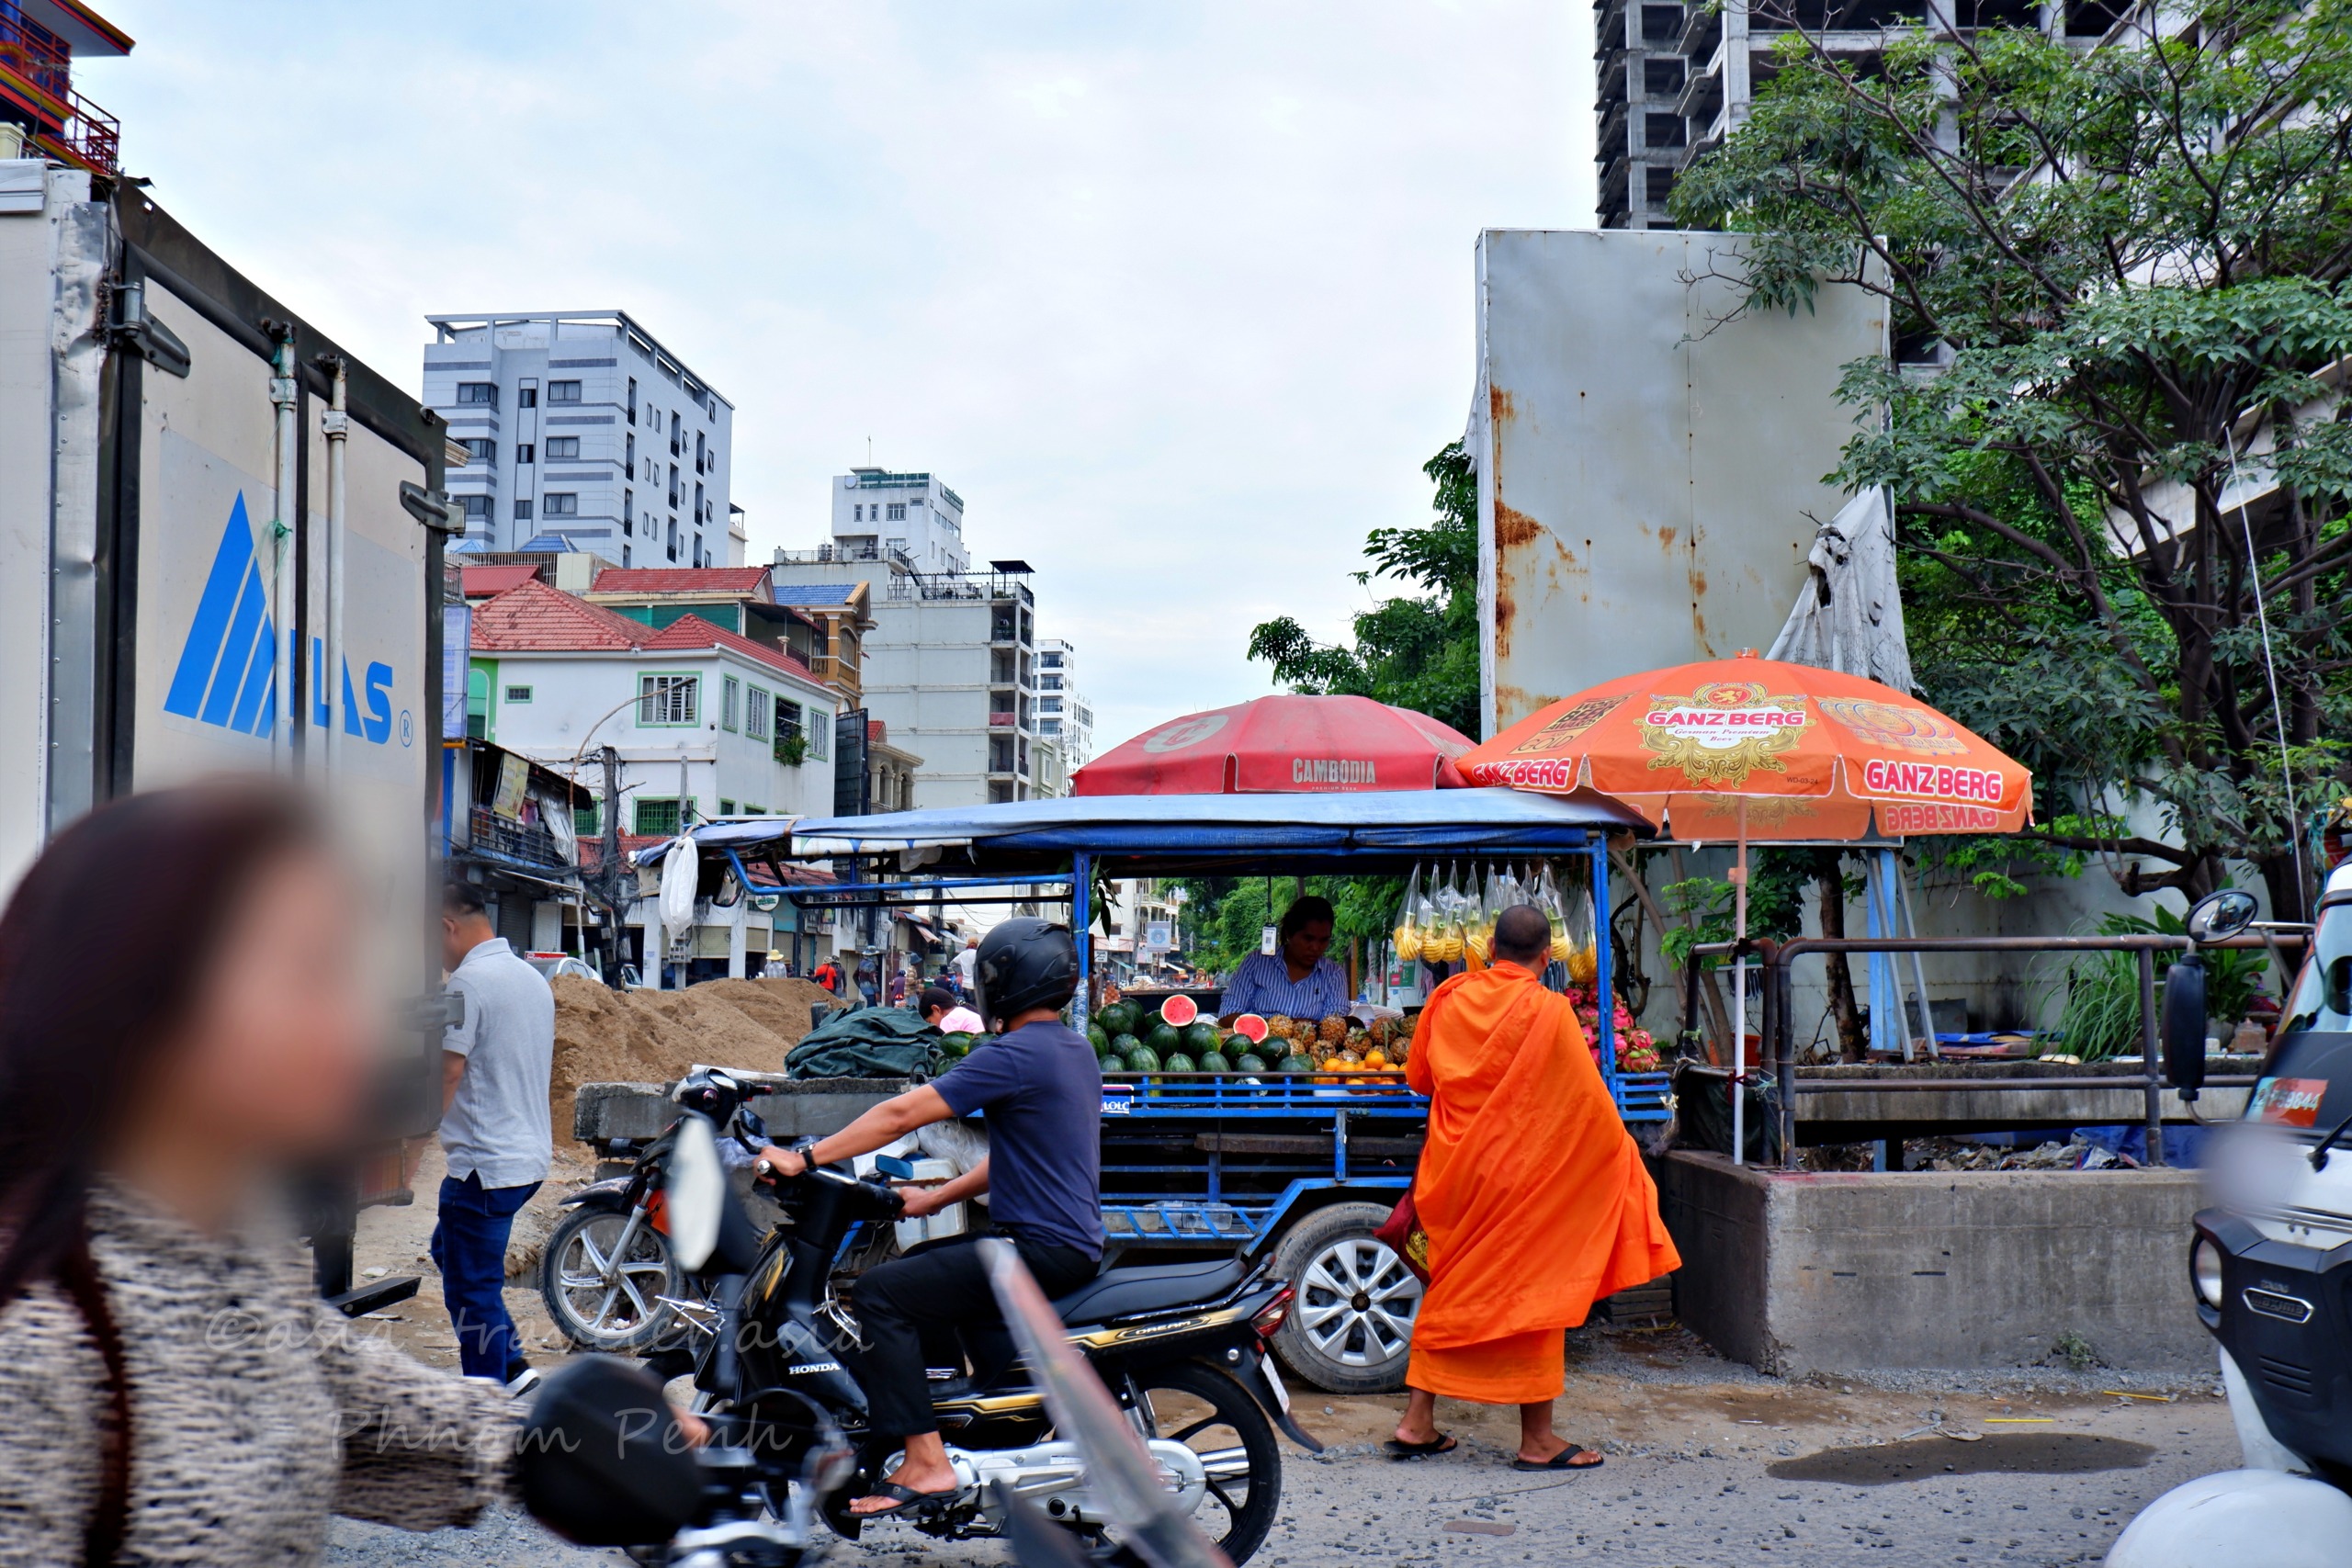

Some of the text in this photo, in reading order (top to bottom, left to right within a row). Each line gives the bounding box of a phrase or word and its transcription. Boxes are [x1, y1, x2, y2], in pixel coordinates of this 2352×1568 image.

[1292, 758, 1376, 784] CAMBODIA
[1786, 776, 1818, 785] WD-03-24
[1103, 1100, 1130, 1111] LOLC
[1135, 1320, 1193, 1337] DREAM
[788, 1361, 841, 1376] HONDA
